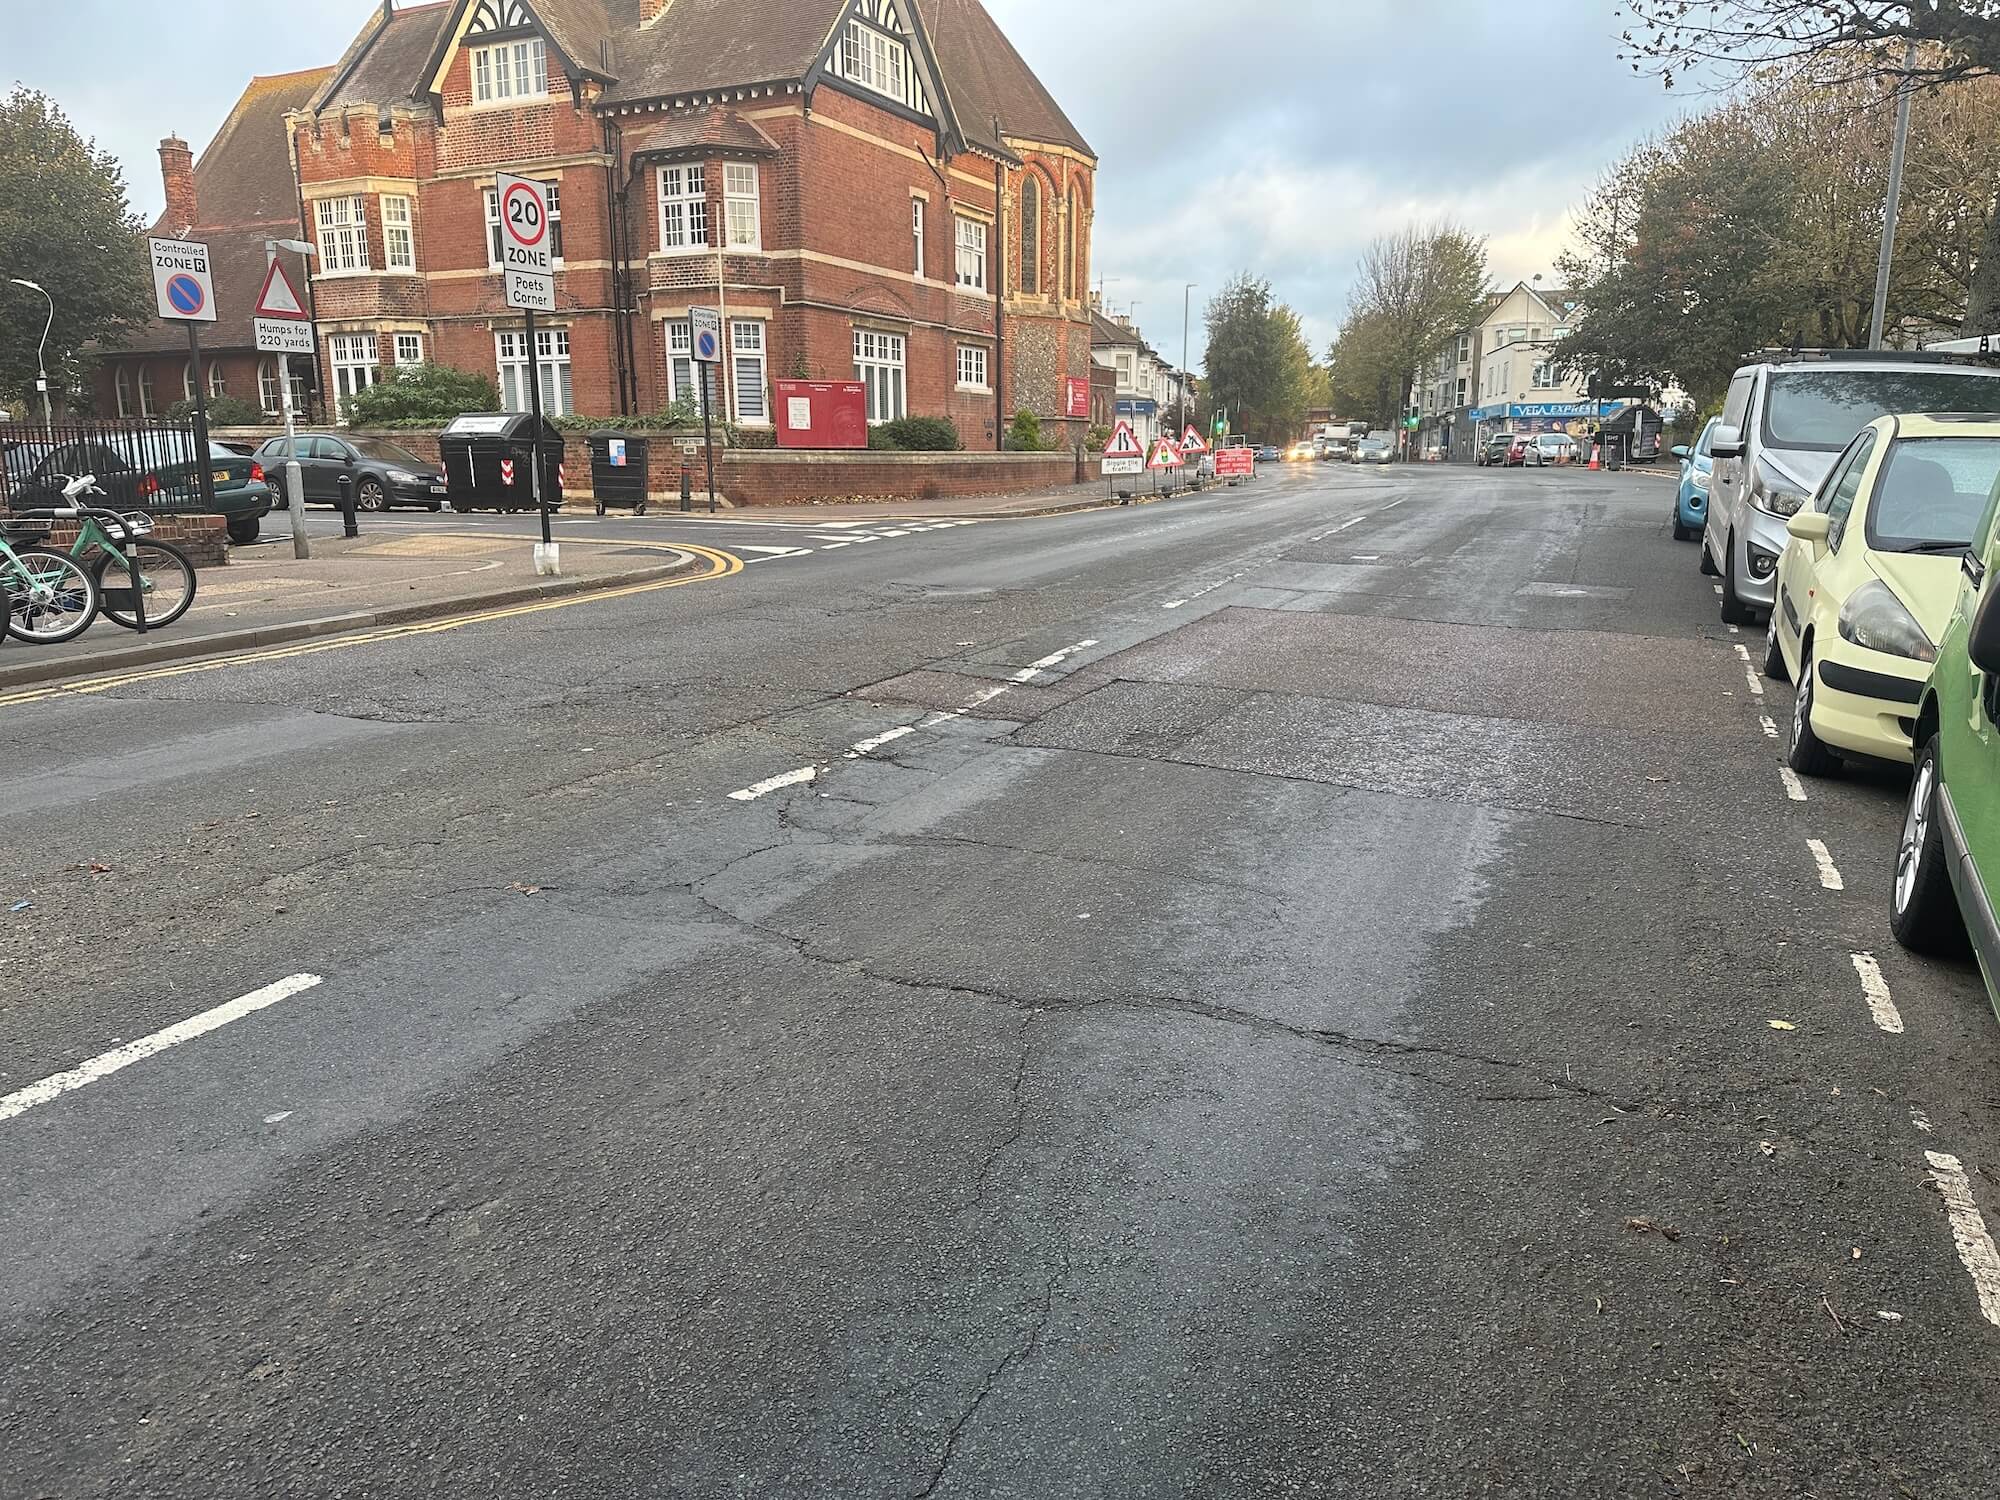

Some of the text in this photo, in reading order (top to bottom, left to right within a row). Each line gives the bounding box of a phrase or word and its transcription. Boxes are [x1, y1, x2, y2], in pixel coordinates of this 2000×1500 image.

[510, 198, 539, 226] 20
[154, 242, 205, 256] Controlled
[156, 256, 206, 272] ZONE R
[508, 247, 547, 267] ZONE
[516, 276, 544, 292] Poets
[513, 291, 547, 306] Corner
[259, 323, 308, 336] Humps for
[694, 319, 711, 329] ZONE
[260, 335, 310, 348] 220 yards
[1514, 405, 1551, 416] VEGA
